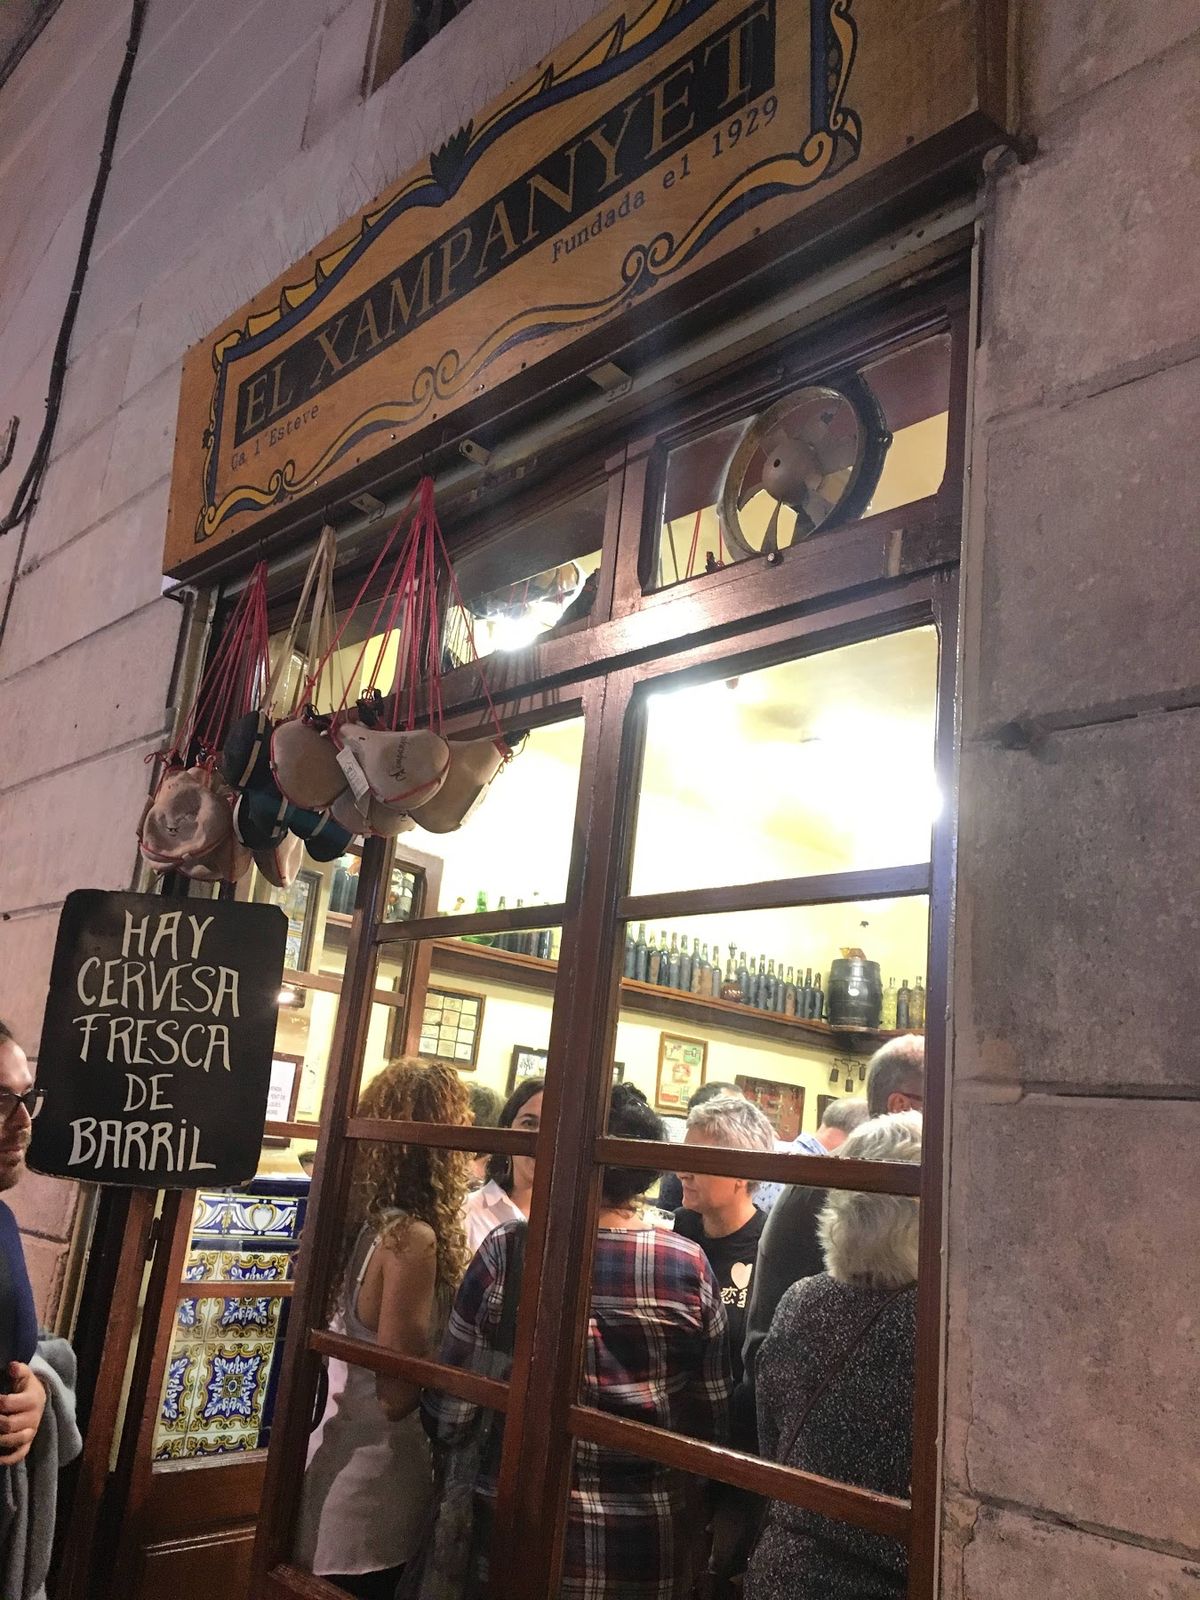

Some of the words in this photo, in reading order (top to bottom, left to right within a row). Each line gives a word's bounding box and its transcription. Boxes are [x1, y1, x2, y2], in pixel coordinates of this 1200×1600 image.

[551, 190, 646, 264] Fundada
[662, 153, 691, 190] el
[711, 95, 778, 158] 1929
[242, 359, 294, 434] EL
[310, 7, 771, 389] XAMPANYET
[121, 910, 214, 961] HAY
[77, 956, 240, 1018] CERVESA
[72, 1012, 231, 1073] FRESCA
[123, 1073, 174, 1112] DE
